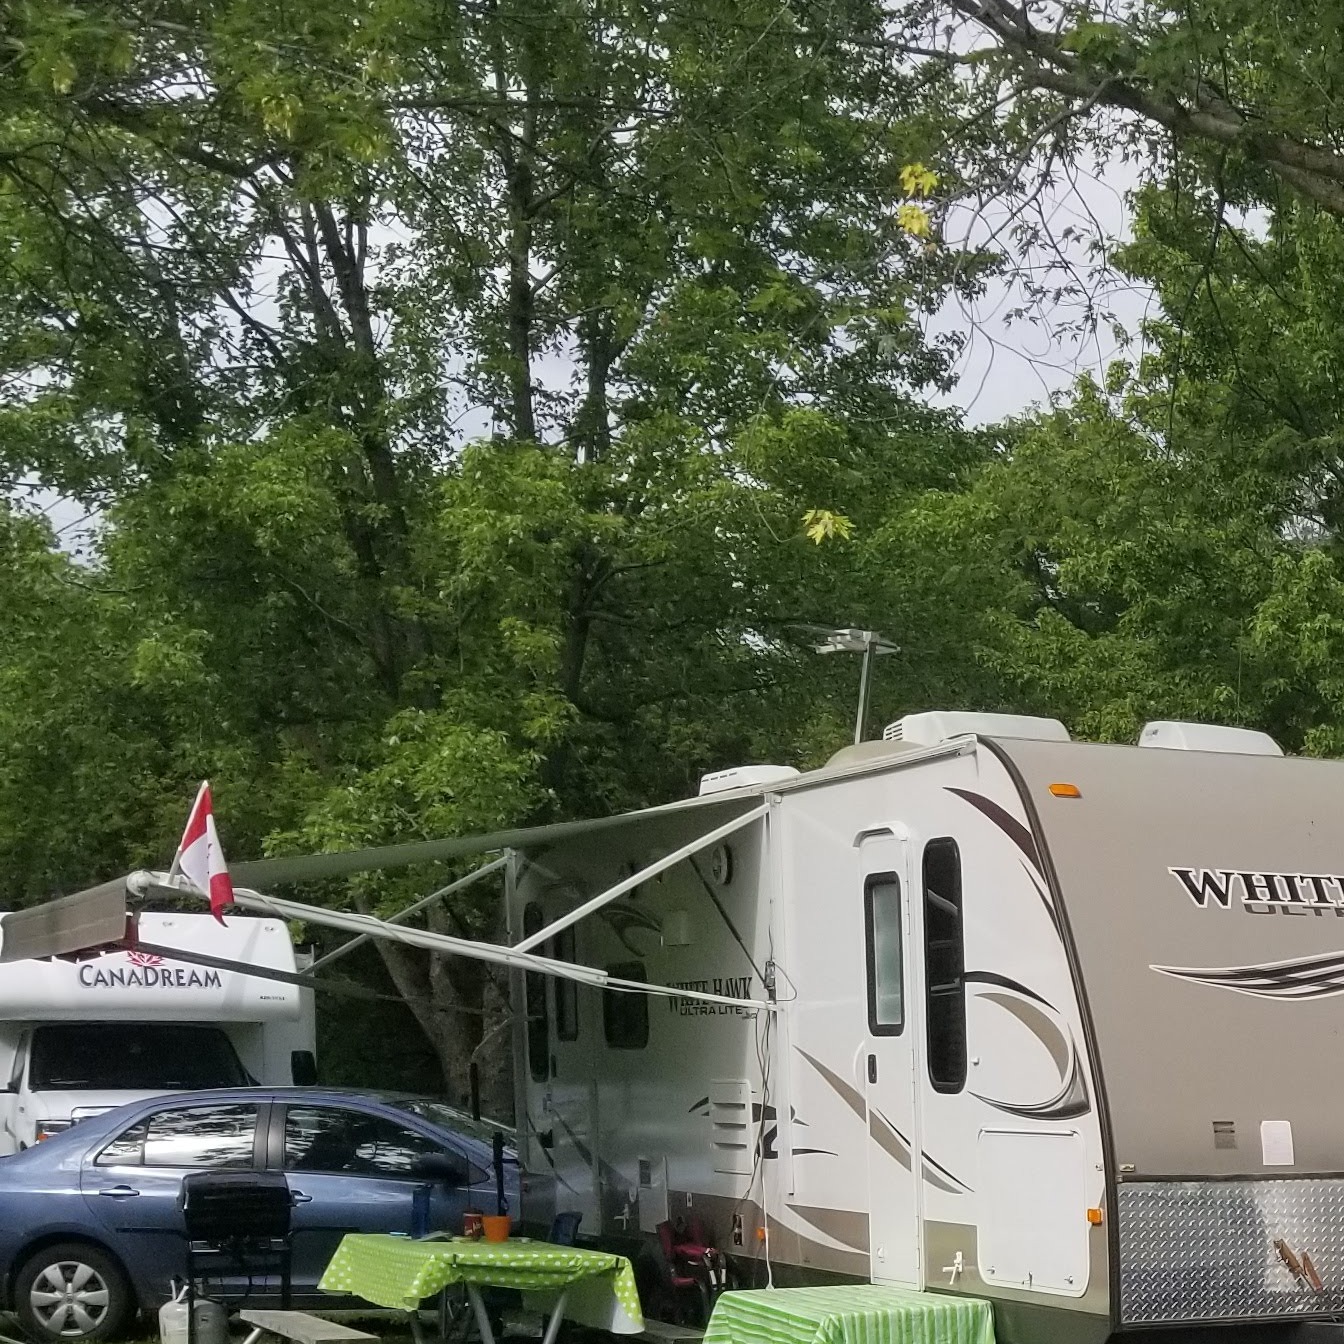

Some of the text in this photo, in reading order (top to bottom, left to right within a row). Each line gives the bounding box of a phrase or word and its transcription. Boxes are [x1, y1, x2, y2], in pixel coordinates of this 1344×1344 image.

[712, 976, 753, 1001] HAWK
[679, 1003, 743, 1016] ULTRA LITE
